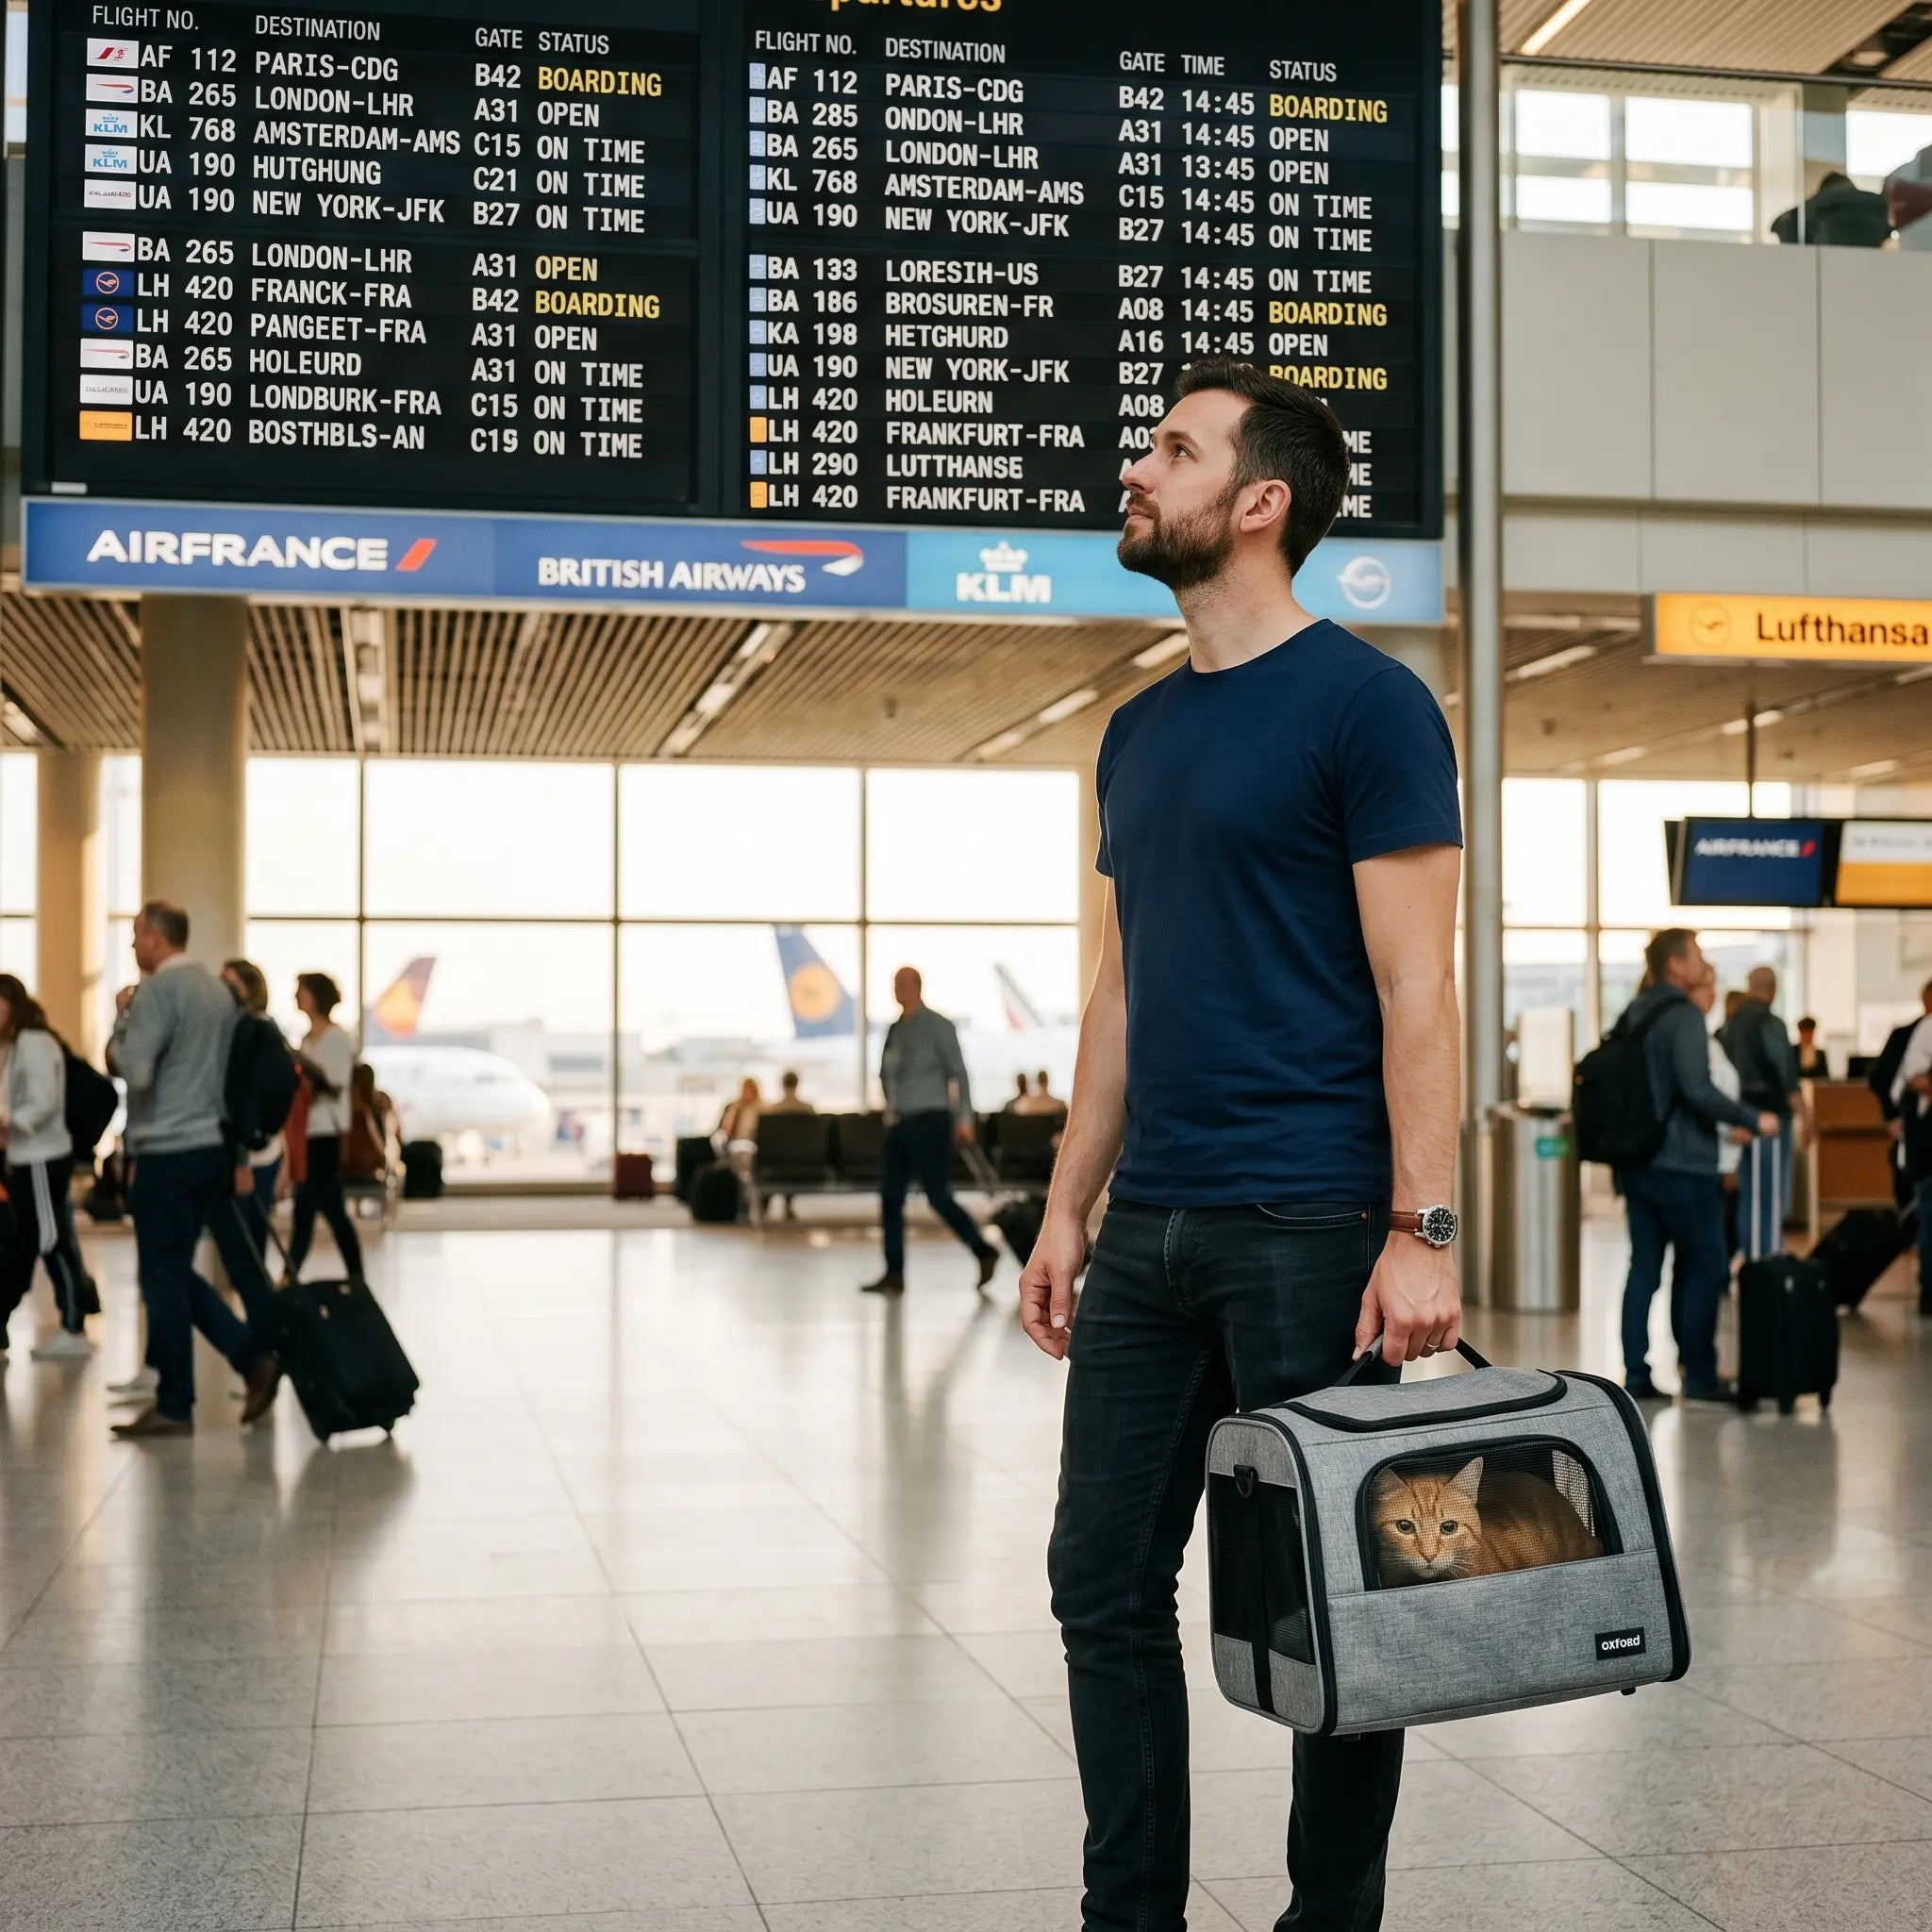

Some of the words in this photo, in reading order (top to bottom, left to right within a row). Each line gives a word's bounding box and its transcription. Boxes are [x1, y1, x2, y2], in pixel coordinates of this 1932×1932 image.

[92, 6, 160, 27] FLIGHT
[166, 10, 199, 30] NO.
[255, 14, 380, 42] DESTINATION
[475, 26, 523, 49] GATE
[538, 31, 609, 55] STATUS
[140, 44, 173, 68] AF
[192, 47, 237, 73] 112
[256, 51, 398, 82] PARIS-CDG
[475, 62, 521, 89] B42
[538, 66, 662, 97] BOARDING
[755, 29, 820, 52] FLIGHT
[825, 34, 858, 55] NO.
[885, 37, 1006, 63] DESTINATION
[1119, 50, 1165, 73] GATE
[1180, 54, 1225, 76] TIME
[1269, 59, 1337, 82] STATUS
[141, 78, 174, 104] BA
[189, 81, 237, 108] 265
[255, 85, 414, 117] LONDON-LHR
[474, 97, 518, 123] A31
[537, 101, 600, 127] OPEN
[766, 66, 798, 91] AF
[813, 69, 858, 94] 112
[886, 73, 1024, 104] PARIS-CDG
[1119, 85, 1165, 111] B42
[1181, 89, 1255, 116] 14:45
[1270, 93, 1388, 124] BOARDING
[93, 123, 128, 134] KLM
[140, 114, 172, 139] KL
[189, 116, 236, 142] 768
[253, 120, 461, 155] AMSTERDAM-AMS
[474, 131, 521, 158] C15
[536, 135, 569, 160] ON
[583, 138, 645, 164] TIME
[767, 99, 799, 125] BA
[811, 102, 858, 128] 285
[885, 106, 1024, 136] ONDON-LHR
[1118, 119, 1161, 143] A31
[1181, 122, 1256, 149] 14:45
[1269, 126, 1329, 153] OPEN
[92, 158, 127, 169] KLM
[139, 149, 173, 175] UA
[189, 152, 236, 177] 190
[253, 155, 381, 186] HUTGHUNG
[473, 166, 517, 192] C21
[536, 169, 568, 195] ON
[583, 172, 645, 199] TIME
[767, 133, 799, 158] BA
[811, 135, 858, 161] 265
[886, 139, 1039, 170] LONDON-LHR
[1118, 151, 1161, 176] A31
[1181, 154, 1255, 181] 13:45
[1269, 158, 1329, 185] OPEN
[139, 184, 172, 209] UA
[188, 187, 235, 213] 190
[252, 190, 302, 216] NEW
[316, 193, 445, 224] YORK-JFK
[473, 201, 521, 226] B27
[536, 204, 568, 230] ON
[582, 206, 645, 234] TIME
[767, 166, 798, 192] KL
[811, 169, 858, 194] 768
[884, 173, 1085, 206] AMSTERDAM-AMS
[1118, 184, 1165, 209] C15
[1181, 187, 1255, 214] 14:45
[1269, 192, 1300, 217] ON
[1313, 194, 1373, 220] TIME
[766, 200, 799, 225] UA
[812, 203, 858, 228] 190
[885, 206, 933, 231] NEW
[946, 208, 1070, 238] YORK-JFK
[1119, 217, 1164, 242] B27
[1181, 220, 1255, 247] 14:45
[1268, 225, 1299, 249] ON
[1313, 226, 1373, 253] TIME
[137, 236, 171, 262] BA
[185, 239, 234, 265] 265
[252, 242, 412, 274] LONDON-LHR
[472, 253, 516, 278] A31
[535, 255, 598, 282] OPEN
[767, 256, 800, 280] BA
[813, 258, 858, 281] 133
[886, 259, 1039, 286] LORESIH-US
[1118, 264, 1164, 289] B27
[1180, 266, 1255, 291] 14:45
[1268, 268, 1299, 292] ON
[1312, 269, 1373, 294] TIME
[138, 273, 170, 298] LH
[184, 275, 234, 301] 420
[251, 277, 412, 308] FRANCK-FRA
[472, 287, 520, 313] B42
[535, 290, 660, 319] BOARDING
[767, 289, 800, 312] BA
[813, 290, 858, 314] 186
[886, 291, 1054, 318] BROSUREN-FR
[1117, 297, 1164, 321] A08
[1180, 298, 1255, 324] 14:45
[1269, 301, 1388, 326] BOARDING
[137, 308, 169, 333] LH
[184, 310, 233, 336] 420
[250, 312, 427, 344] PANGEET-FRA
[471, 323, 515, 348] A31
[534, 325, 597, 352] OPEN
[767, 321, 800, 344] KA
[813, 323, 858, 346] 198
[885, 324, 1009, 349] HETGHURD
[1118, 329, 1164, 353] A16
[1180, 330, 1255, 356] 14:45
[1268, 332, 1328, 357] OPEN
[135, 343, 169, 369] BA
[184, 345, 232, 372] 265
[249, 348, 362, 376] HOLEURD
[471, 357, 515, 383] A31
[534, 359, 566, 385] ON
[580, 361, 643, 389] TIME
[767, 354, 800, 377] UA
[813, 355, 858, 378] 190
[885, 356, 933, 380] NEW
[945, 358, 1070, 383] YORK-JFK
[1119, 361, 1164, 386] B27
[135, 379, 169, 405] UA
[185, 381, 232, 408] 190
[250, 383, 442, 416] LONDBURK-FRA
[471, 392, 518, 418] C15
[533, 394, 566, 421] ON
[580, 396, 643, 424] TIME
[768, 386, 799, 410] LH
[811, 387, 858, 411] 420
[885, 389, 993, 414] HOLEURN
[1118, 393, 1165, 416] A08
[135, 415, 167, 441] LH
[182, 417, 232, 442] 420
[248, 419, 425, 450] BOSTHBLS-AN
[533, 429, 565, 456] ON
[579, 431, 643, 458] TIME
[768, 419, 799, 442] LH
[811, 420, 858, 444] 420
[886, 421, 1085, 448] FRANKFURT-FRA
[1118, 426, 1156, 449] A0
[768, 451, 799, 475] LH
[811, 452, 858, 476] 290
[768, 483, 799, 508] LH
[811, 484, 858, 508] 420
[887, 485, 1086, 513] FRANKFURT-FRA
[86, 529, 389, 571] AIRFRANCE
[538, 557, 662, 589] BRITISH
[669, 561, 806, 593] AIRWAYS
[956, 572, 1052, 604] KLM
[1757, 612, 1928, 646] Lufthansa
